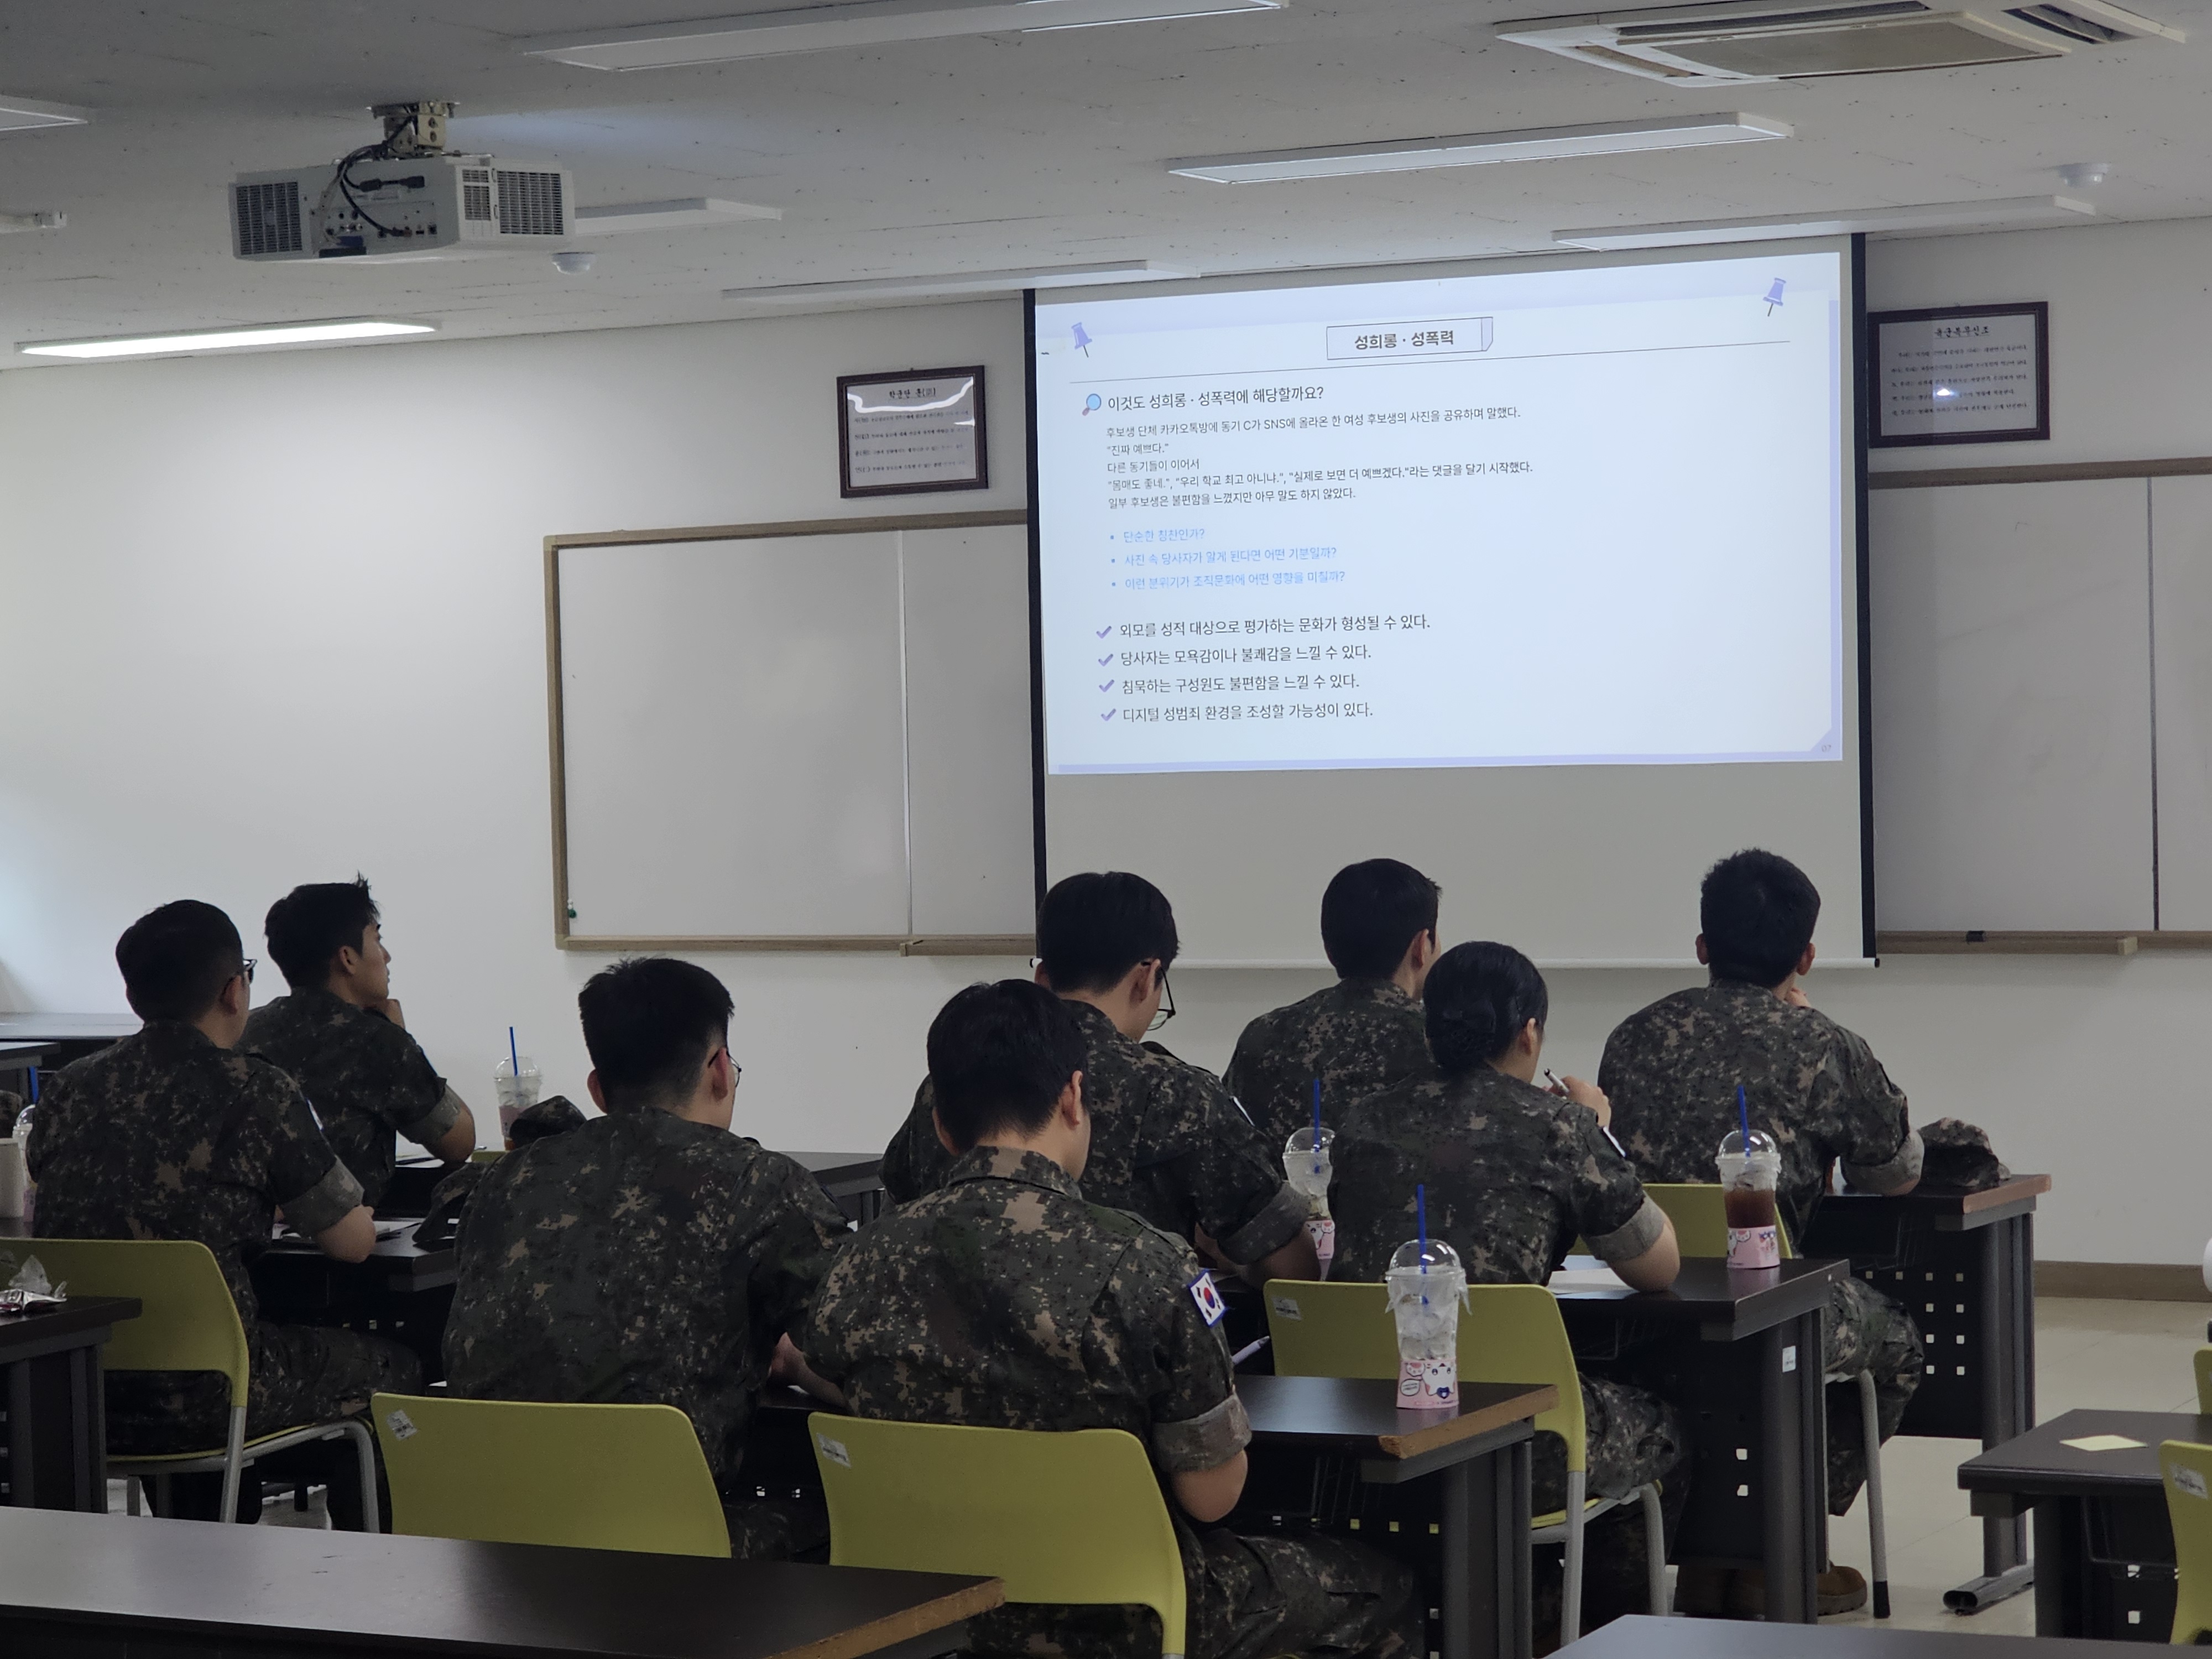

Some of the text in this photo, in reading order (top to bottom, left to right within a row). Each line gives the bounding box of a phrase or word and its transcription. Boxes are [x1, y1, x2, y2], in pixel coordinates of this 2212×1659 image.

[1354, 333, 1397, 351] 성희롱
[1411, 330, 1454, 347] 성폭력
[1108, 395, 1146, 412] 이것도
[1149, 393, 1187, 409] 성희롱
[1198, 388, 1249, 406] 성폭력에
[1252, 385, 1324, 403] 해당할까요?
[1106, 406, 1521, 439] 후보생 단체 카카오톡방에 동기 C가 SNS에 올라온 한 여성 후보생의 사진을 공유하며 말했다.
[1107, 458, 1199, 474] 다른 동기들이 이어서
[1202, 475, 1222, 487] 학교
[1224, 474, 1244, 486] 최고
[1326, 468, 1346, 481] 보면
[1349, 468, 1359, 481] 더
[1432, 463, 1463, 477] 댓글을
[1465, 462, 1486, 476] 달기
[1489, 461, 1533, 474] 시작했다.
[1108, 487, 1357, 510] 일부 후보생은 불편함을 느꼈지만 아무 말도 하지 않았다.
[1123, 528, 1205, 543] 단순한 칭찬인가?
[1125, 546, 1337, 566] 사진 속 당사자가 알게 된다면 어떤 기분일까?
[1125, 570, 1345, 590] 이런 분위기가 조직문화에 어떤 영향을 미칠까?
[1120, 613, 1431, 639] 외모를 성적 대상으로 평가하는 문화가 형성될 수 있다.
[1120, 644, 1371, 666] 당사자는 모욕감이나 불쾌감을 느낄 수 있다.
[1122, 673, 1360, 695] 침묵하는 구성원도 불편함을 느낄 수 있다.
[1123, 702, 1373, 723] 디지털 성범죄 환경을 조성할 가능성이 있다.
